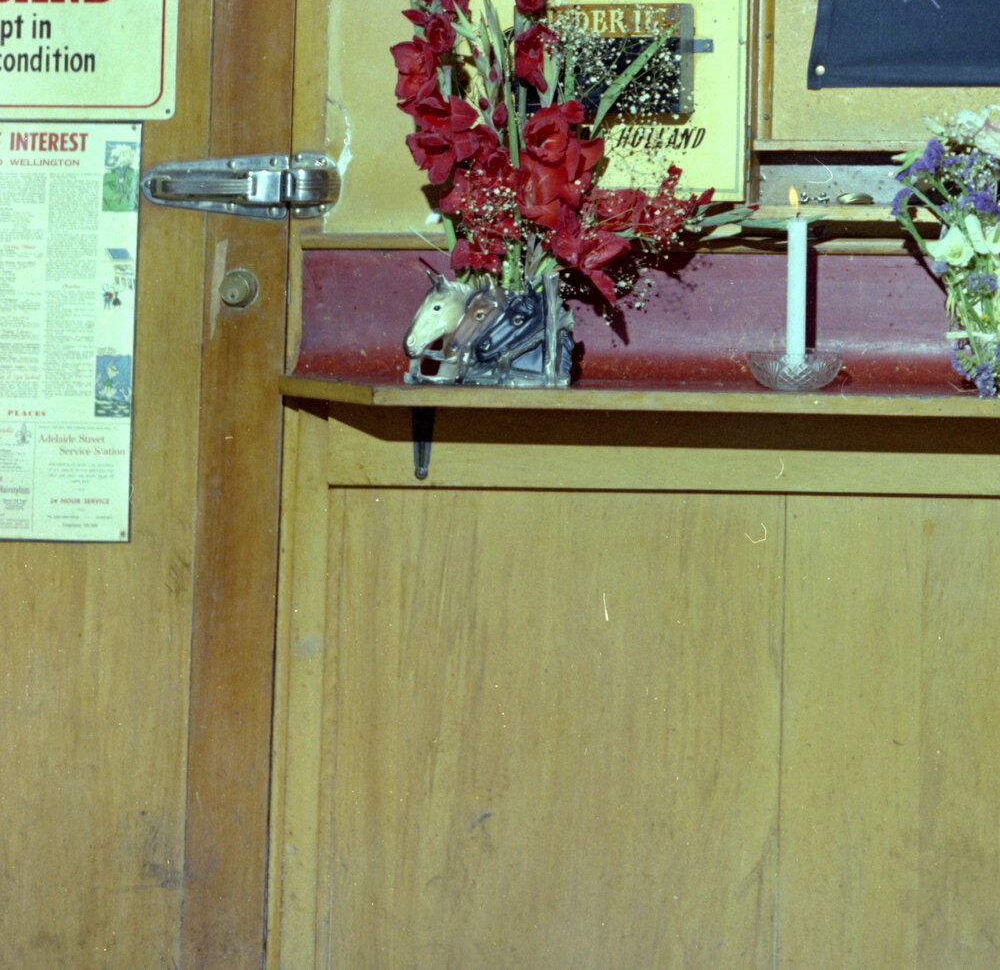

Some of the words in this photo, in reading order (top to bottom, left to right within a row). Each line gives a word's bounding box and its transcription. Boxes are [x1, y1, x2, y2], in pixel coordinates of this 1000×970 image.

[32, 12, 52, 39] in
[0, 46, 96, 73] ondition
[10, 132, 89, 152] INTEREST
[616, 127, 706, 149] HOLLAND
[10, 158, 80, 167] WELLINGTON
[59, 446, 91, 456] Service
[94, 446, 126, 456] Station
